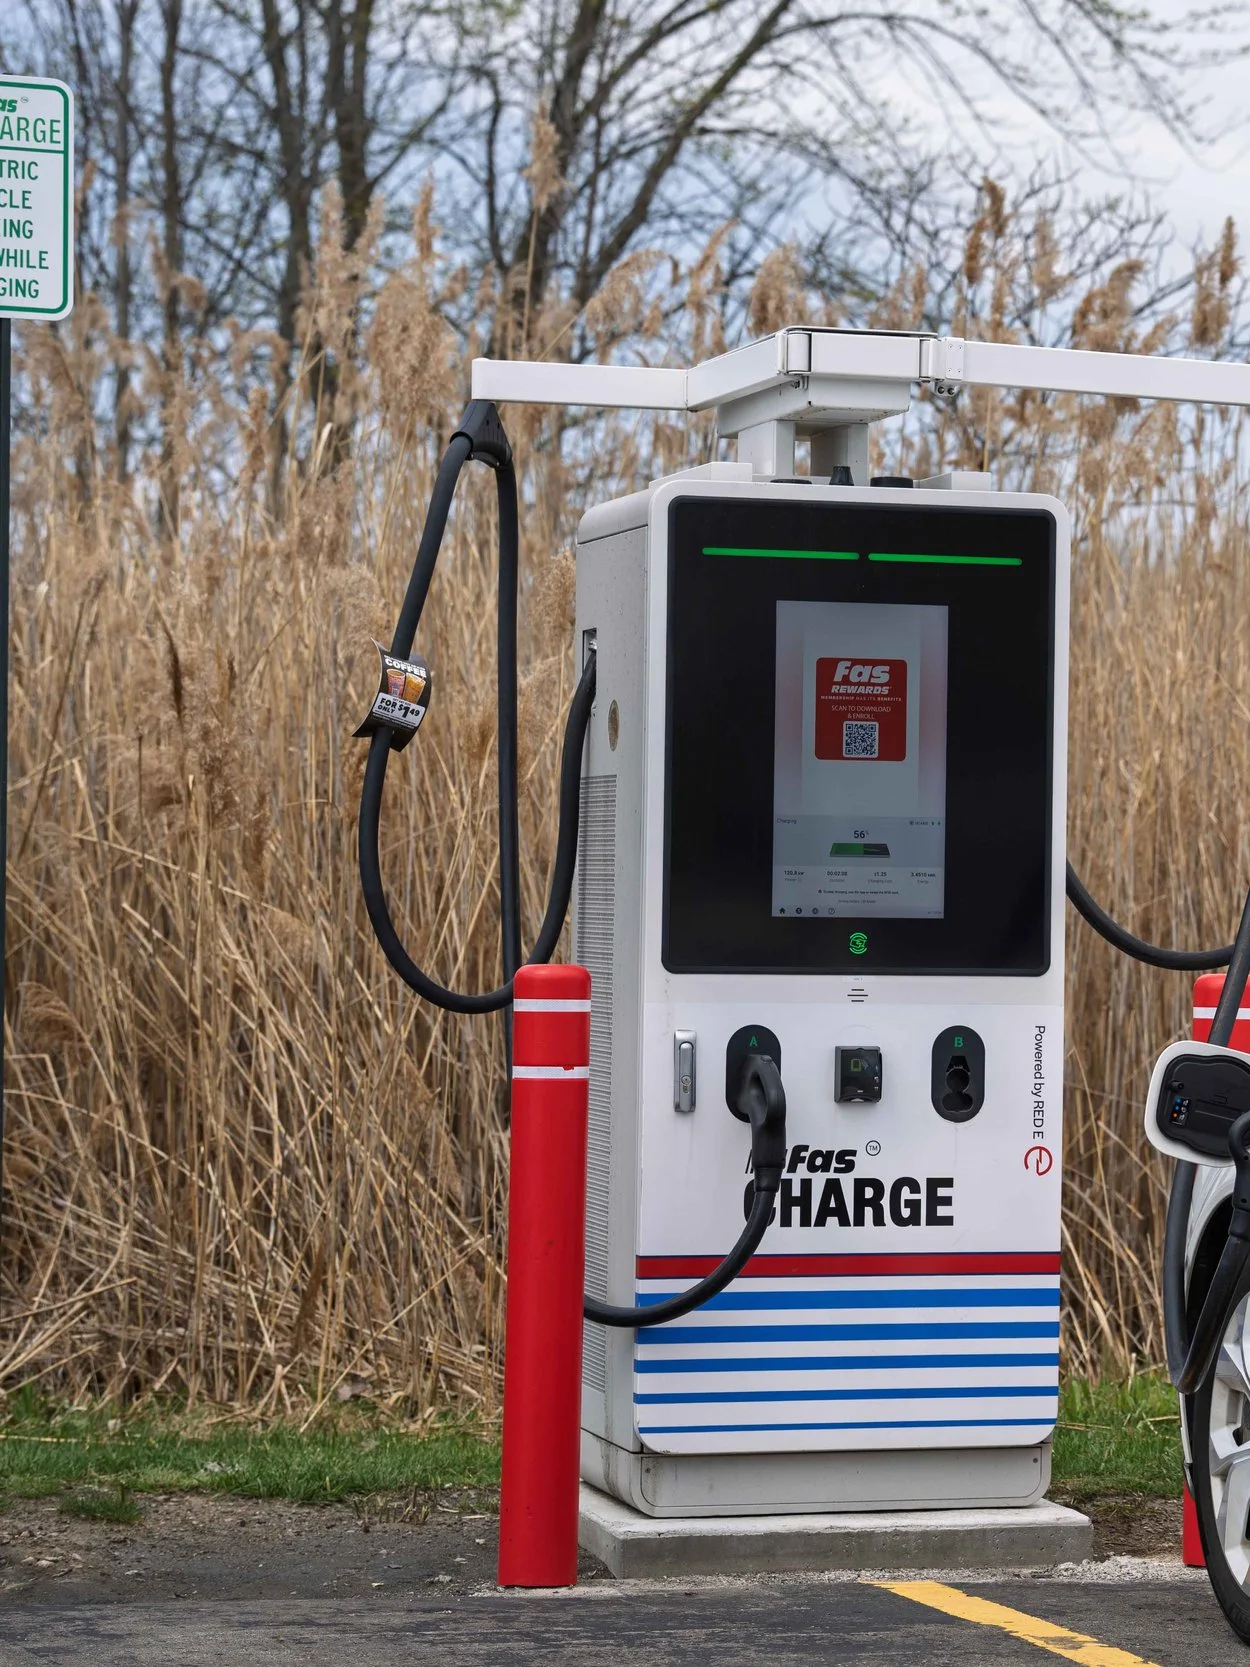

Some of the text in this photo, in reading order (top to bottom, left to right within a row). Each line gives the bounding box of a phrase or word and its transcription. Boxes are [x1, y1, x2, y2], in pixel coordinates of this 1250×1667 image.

[0, 218, 33, 239] ING
[384, 658, 427, 678] COFFEE
[831, 685, 889, 695] REWARDS
[380, 697, 398, 709] FOR
[377, 704, 396, 714] ONLY
[857, 705, 891, 713] DOWNLOAD
[749, 1035, 758, 1046] A
[954, 1036, 964, 1047] B
[1031, 1025, 1046, 1140] Powered by RED E
